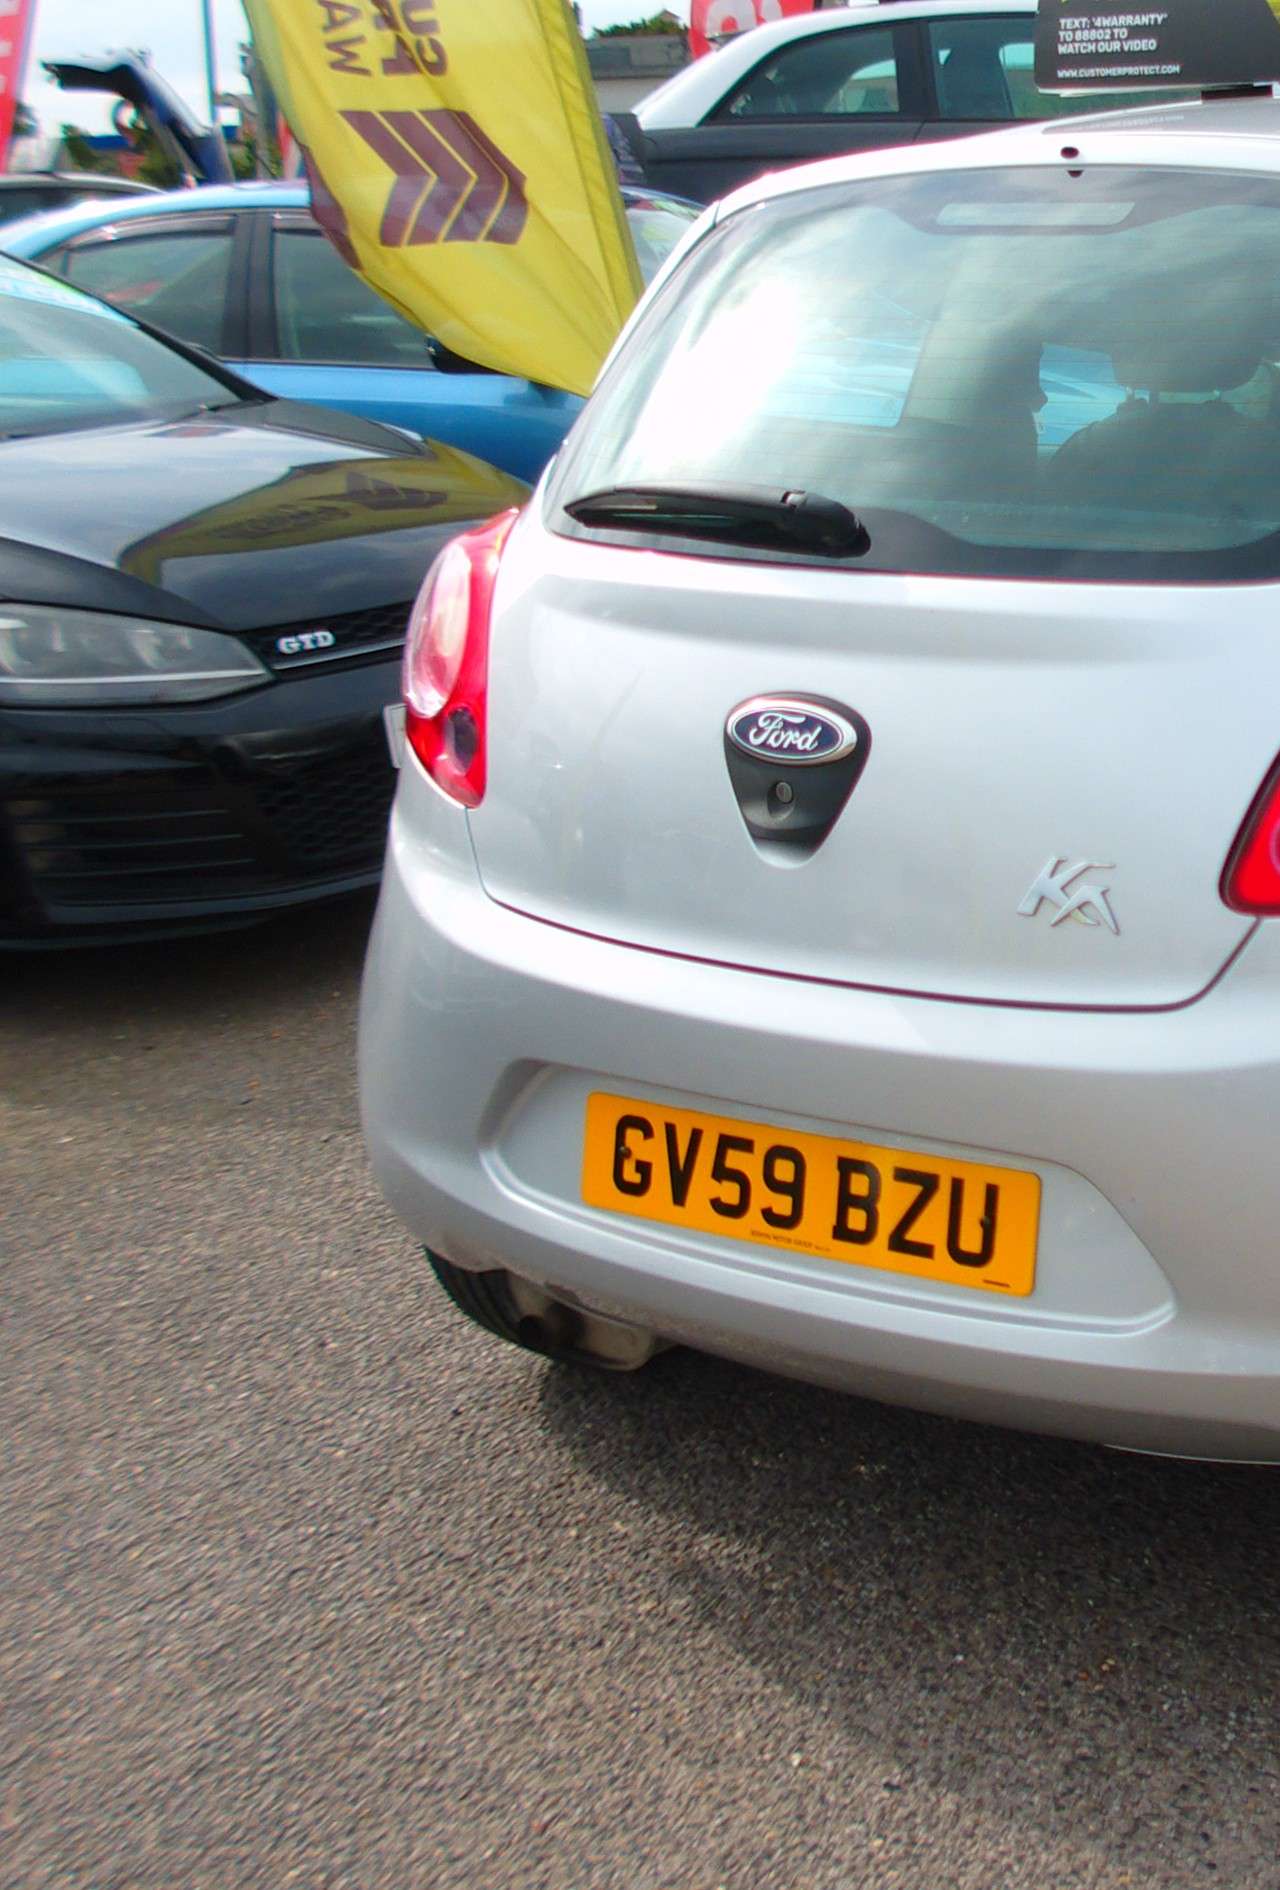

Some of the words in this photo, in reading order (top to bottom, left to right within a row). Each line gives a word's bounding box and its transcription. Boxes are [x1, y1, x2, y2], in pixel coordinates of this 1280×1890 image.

[1059, 17, 1090, 30] TEXT:
[1058, 30, 1074, 42] TO
[1075, 28, 1112, 41] 88802
[1114, 27, 1129, 39] TO
[1057, 42, 1096, 55] WATCH
[1097, 40, 1121, 53] OUR
[1122, 39, 1158, 51] VIDEO
[278, 630, 335, 655] GTD
[748, 711, 823, 752] Ford
[612, 1114, 808, 1231] GV59
[832, 1155, 1000, 1269] BZU
